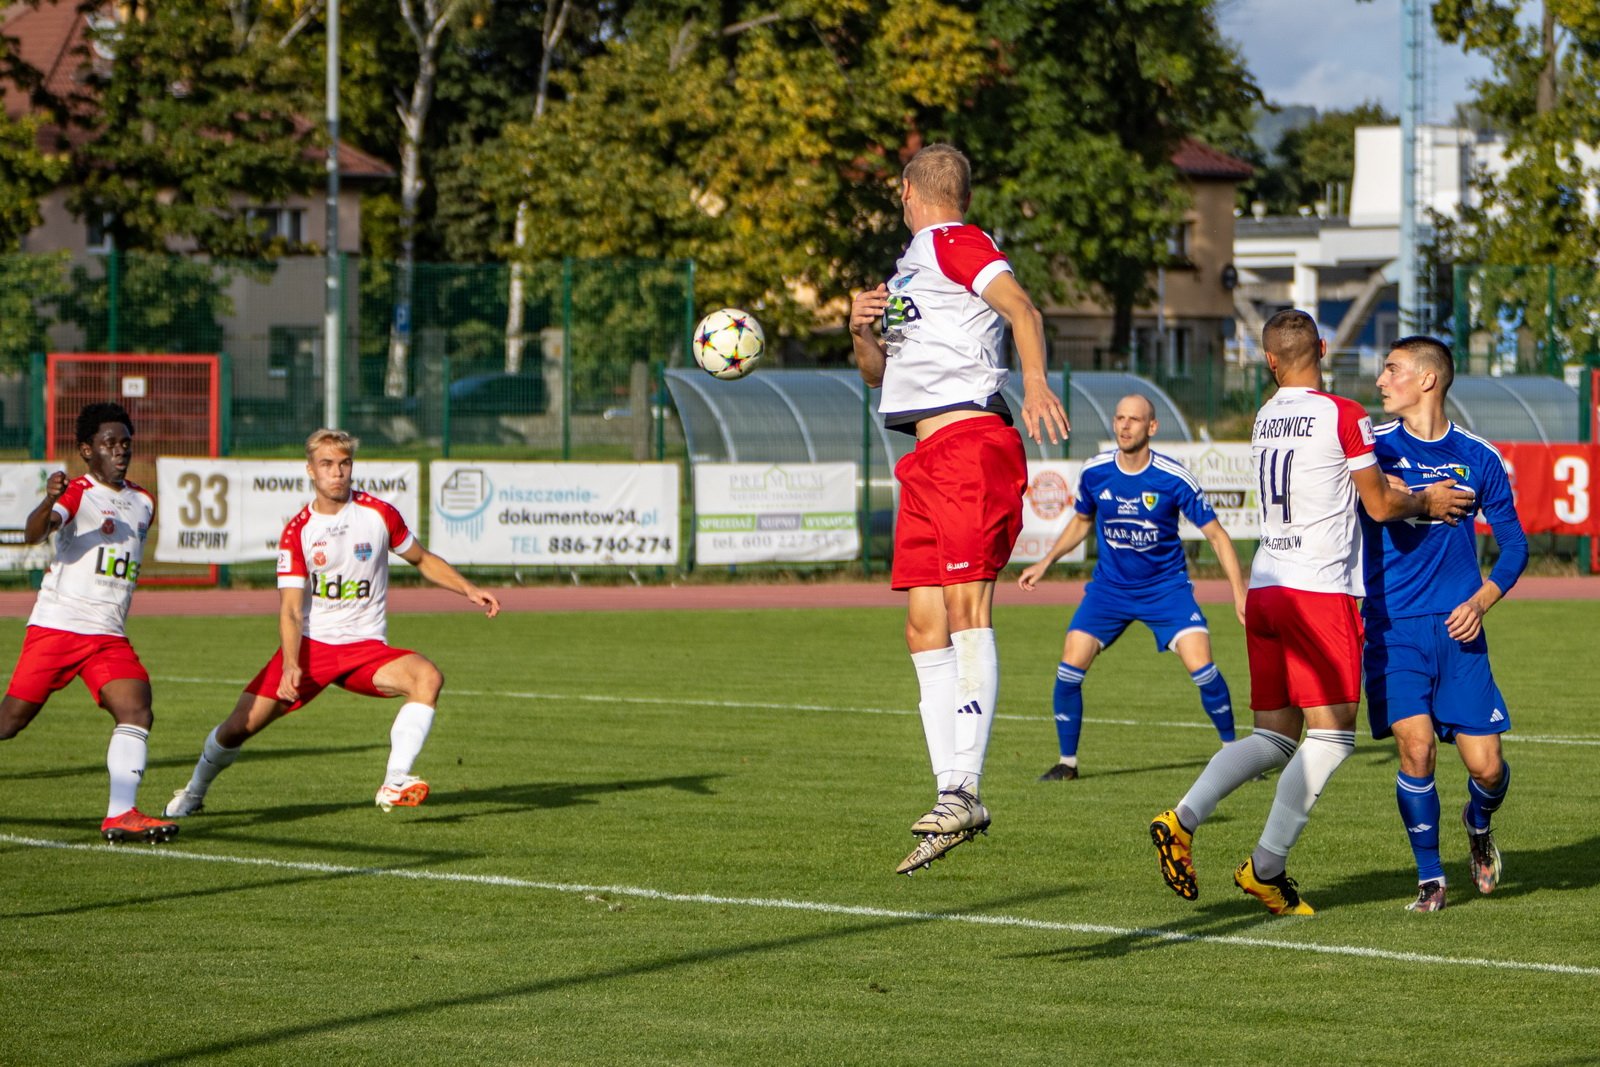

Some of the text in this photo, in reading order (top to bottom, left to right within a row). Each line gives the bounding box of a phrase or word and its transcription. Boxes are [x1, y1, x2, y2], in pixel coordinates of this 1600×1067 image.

[253, 477, 304, 491] NOWE
[498, 486, 600, 503] niszczenie-
[1259, 449, 1294, 523] 14
[1553, 456, 1590, 525] 3
[177, 472, 229, 528] 33
[498, 508, 659, 527] dokumentow24.pl
[178, 531, 229, 549] KIEPURY
[511, 536, 672, 555] TEL 886-740-274
[95, 546, 141, 582] Lide
[312, 572, 370, 600] Lidea
